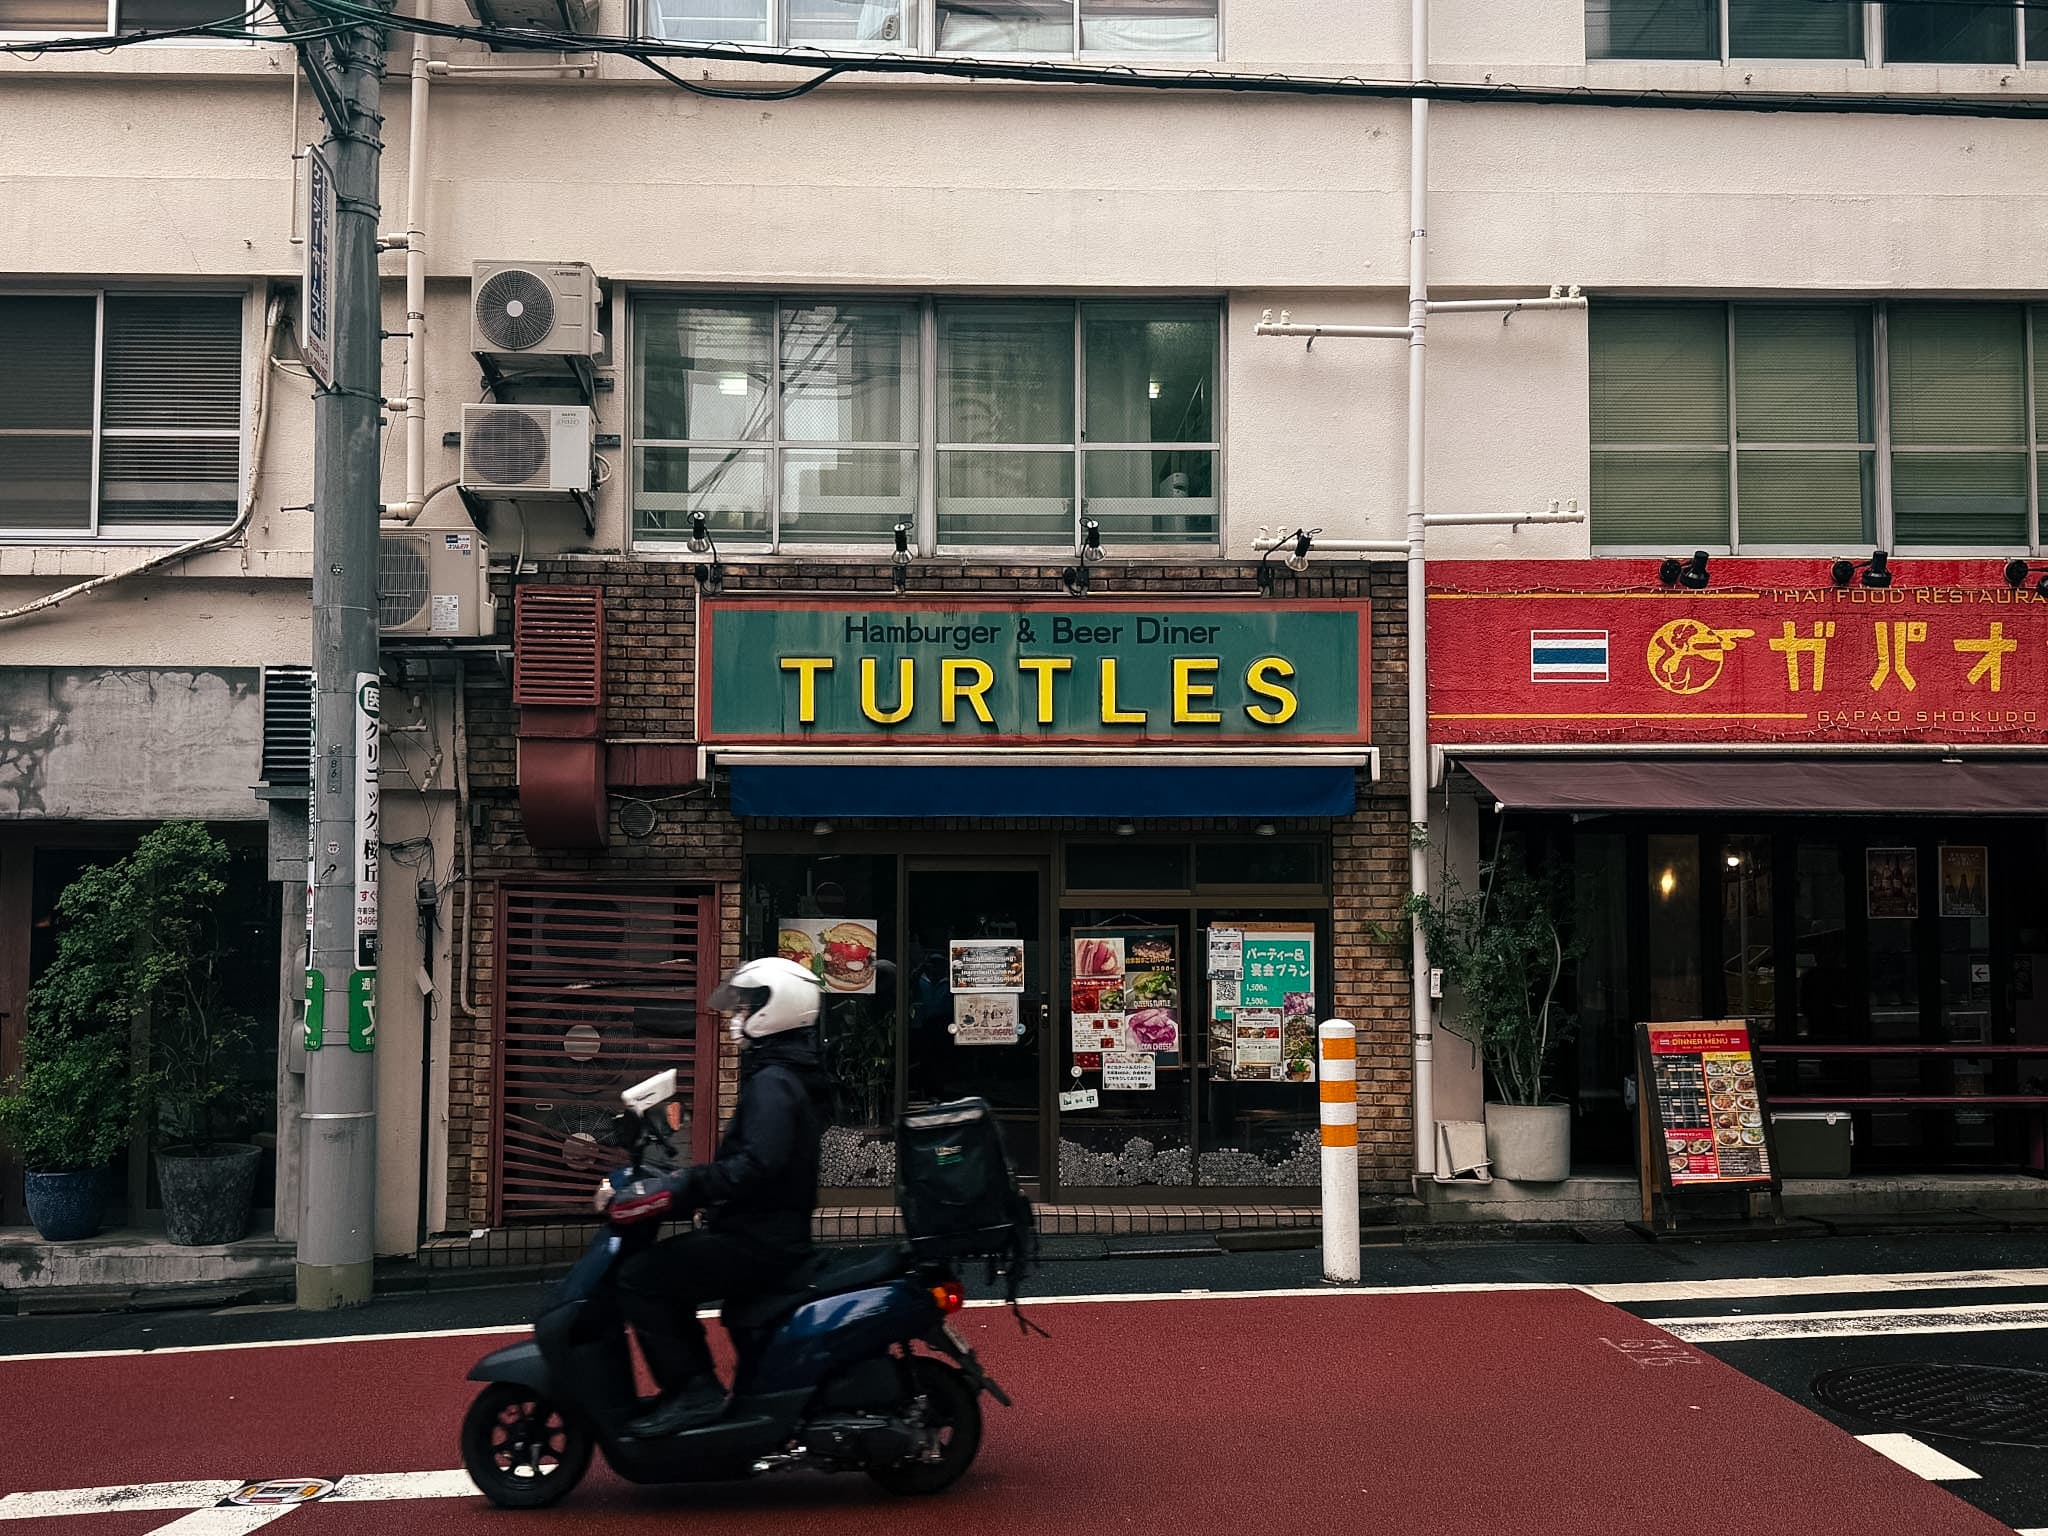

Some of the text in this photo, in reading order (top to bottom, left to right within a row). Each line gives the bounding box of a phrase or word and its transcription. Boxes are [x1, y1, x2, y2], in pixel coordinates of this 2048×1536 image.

[1772, 589, 1826, 604] THAI
[1836, 589, 1905, 604] FOOD
[844, 616, 1221, 651] Hamburger & Beer Diner
[1769, 620, 2018, 693] ガパオ
[779, 656, 1299, 725] TURTLES
[1817, 710, 2037, 722] GAPAO SHOKUDO
[1671, 1037, 1728, 1046] DINNER MENU
